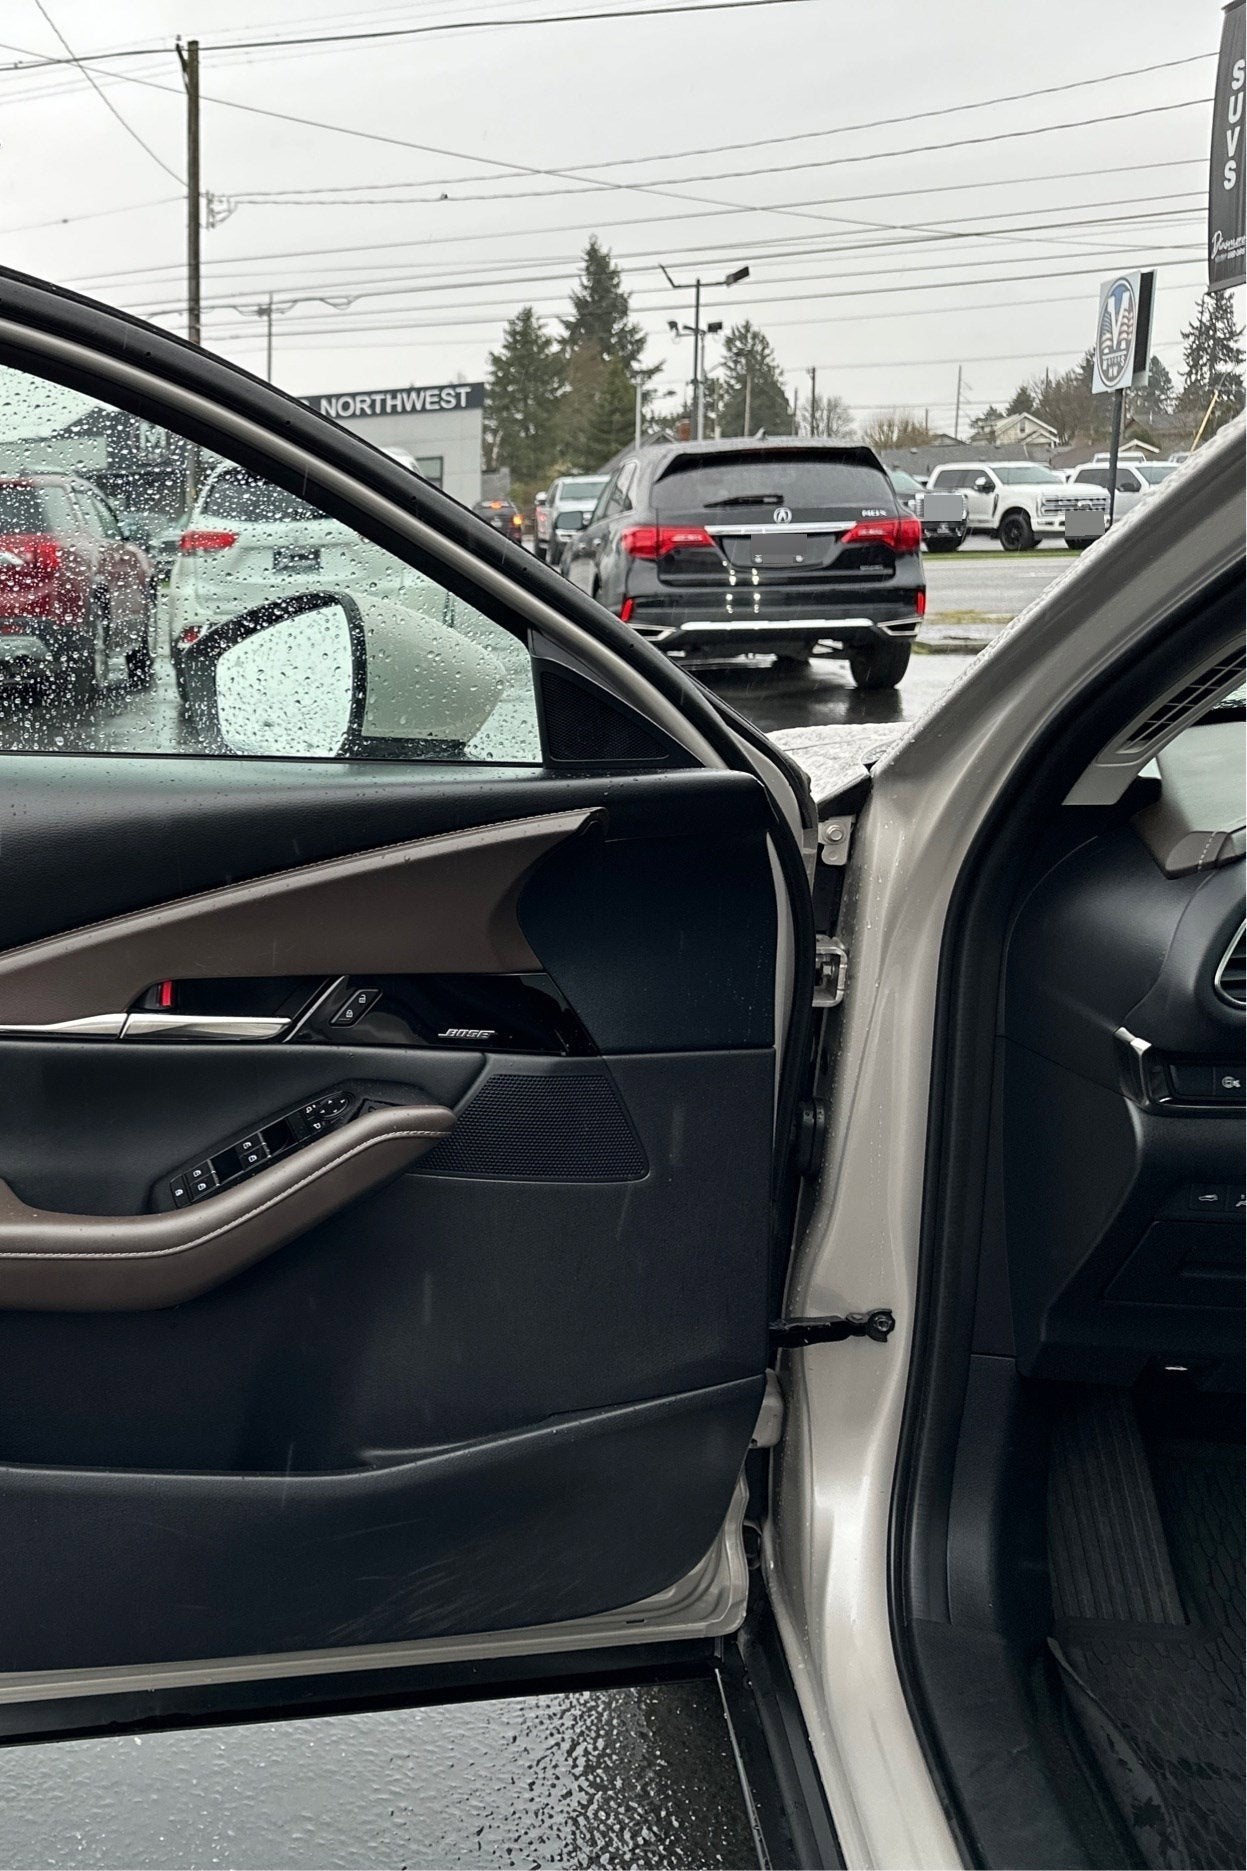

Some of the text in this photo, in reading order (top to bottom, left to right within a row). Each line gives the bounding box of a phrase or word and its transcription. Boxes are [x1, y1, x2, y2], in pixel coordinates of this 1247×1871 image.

[1223, 59, 1245, 190] SUVS
[320, 386, 471, 418] NORTHWEST
[438, 1028, 495, 1039] BOSE
